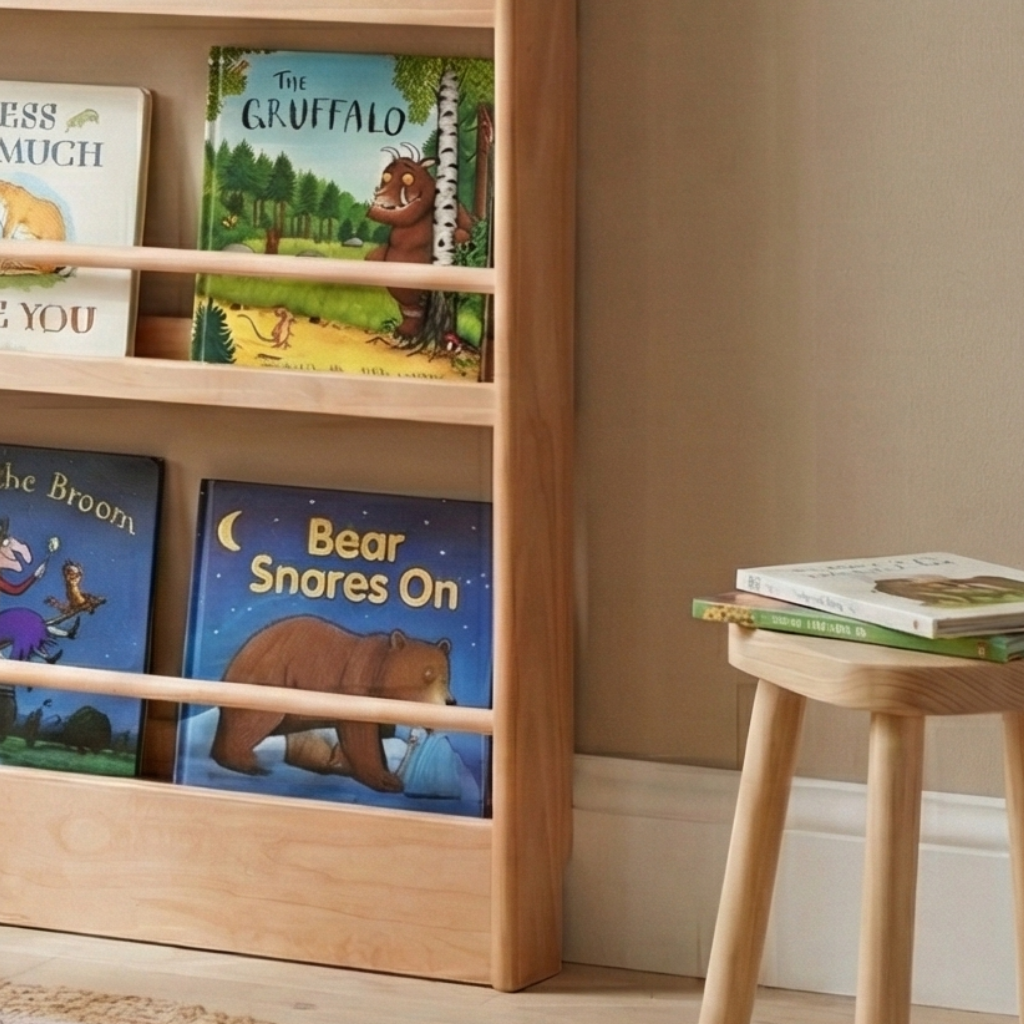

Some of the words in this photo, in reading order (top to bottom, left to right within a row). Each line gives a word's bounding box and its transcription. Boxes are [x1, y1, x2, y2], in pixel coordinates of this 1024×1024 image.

[241, 98, 406, 136] GRUFFALO
[20, 302, 97, 334] YOU
[47, 471, 136, 536] Broom
[308, 517, 406, 563] Bear
[399, 567, 459, 610] On
